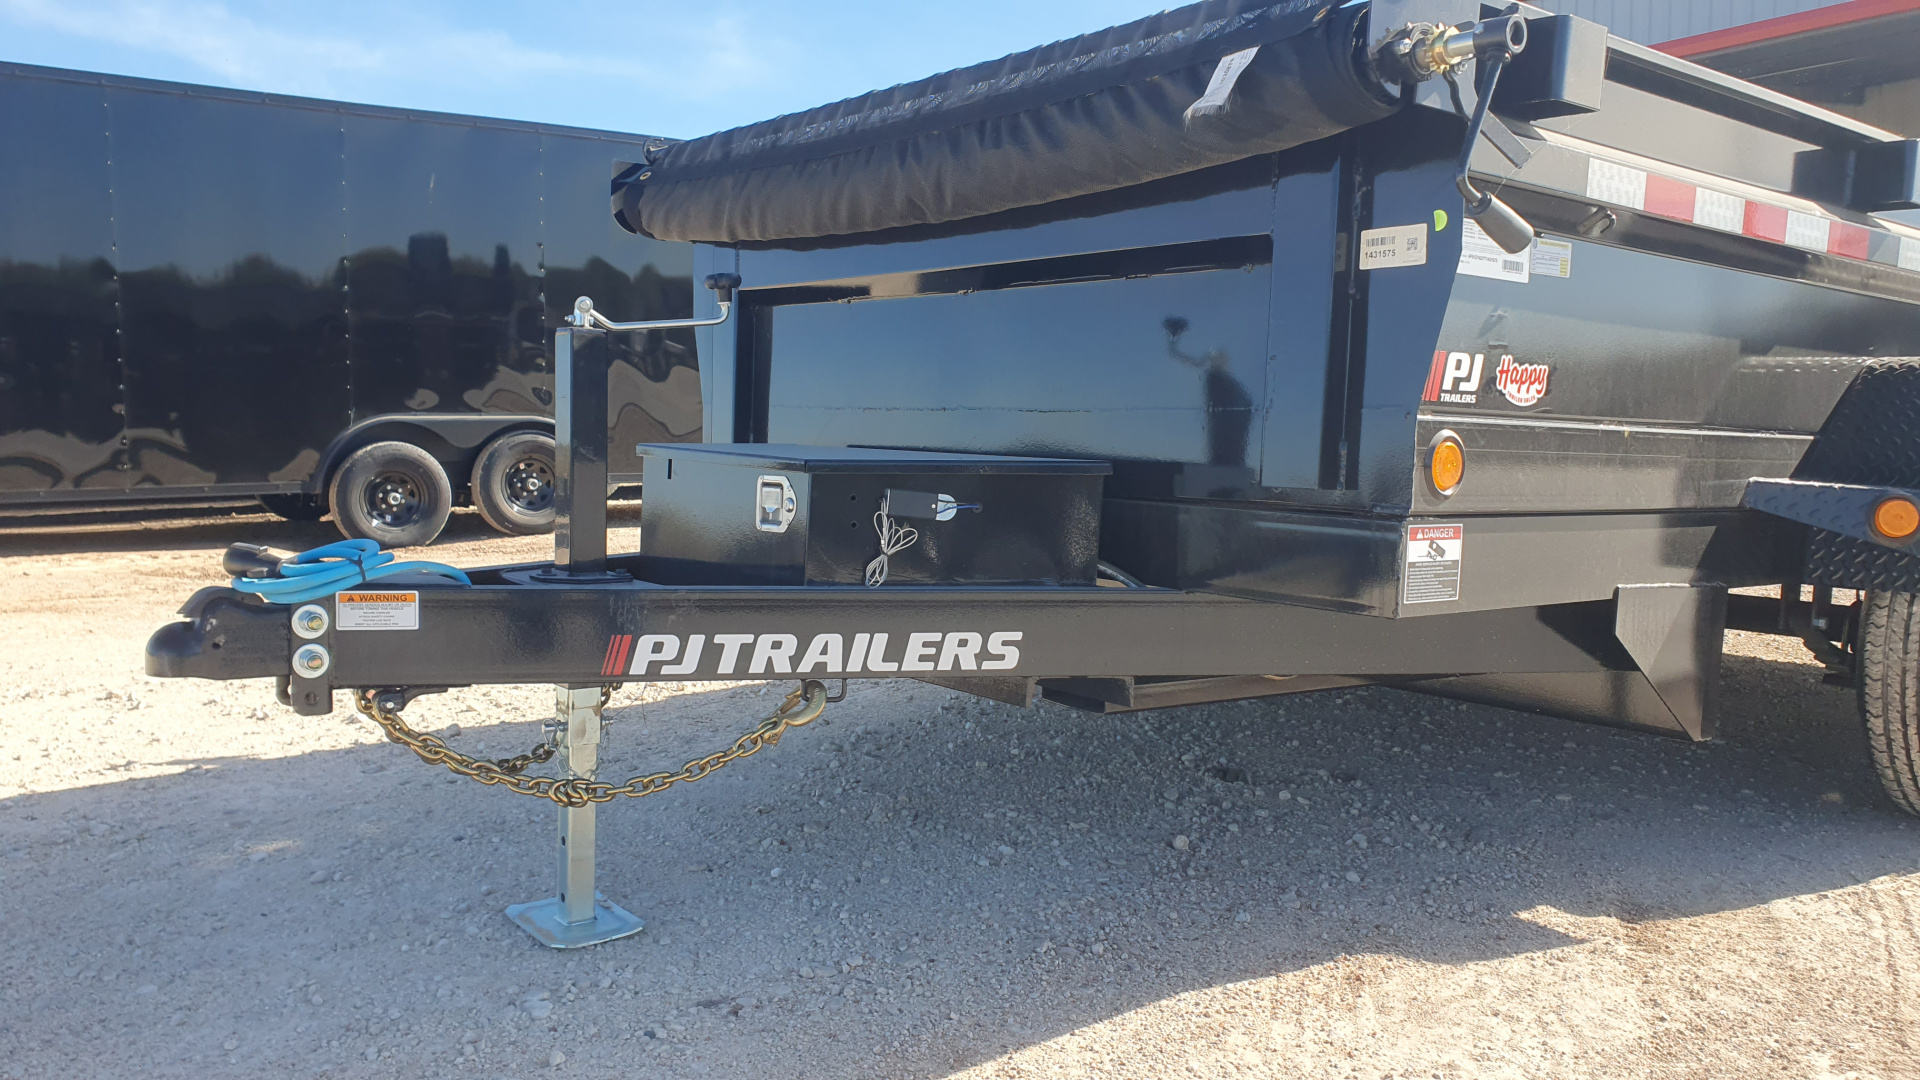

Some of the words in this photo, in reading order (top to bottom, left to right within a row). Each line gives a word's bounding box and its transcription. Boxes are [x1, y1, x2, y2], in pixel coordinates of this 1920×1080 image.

[1365, 249, 1396, 259] 1431575
[1442, 351, 1485, 392] PJ
[1497, 357, 1547, 395] Happy
[1440, 393, 1477, 403] TRAILERS
[1424, 529, 1454, 538] DANGER
[628, 634, 706, 676] PJ
[713, 631, 1023, 675] TRAILERS
